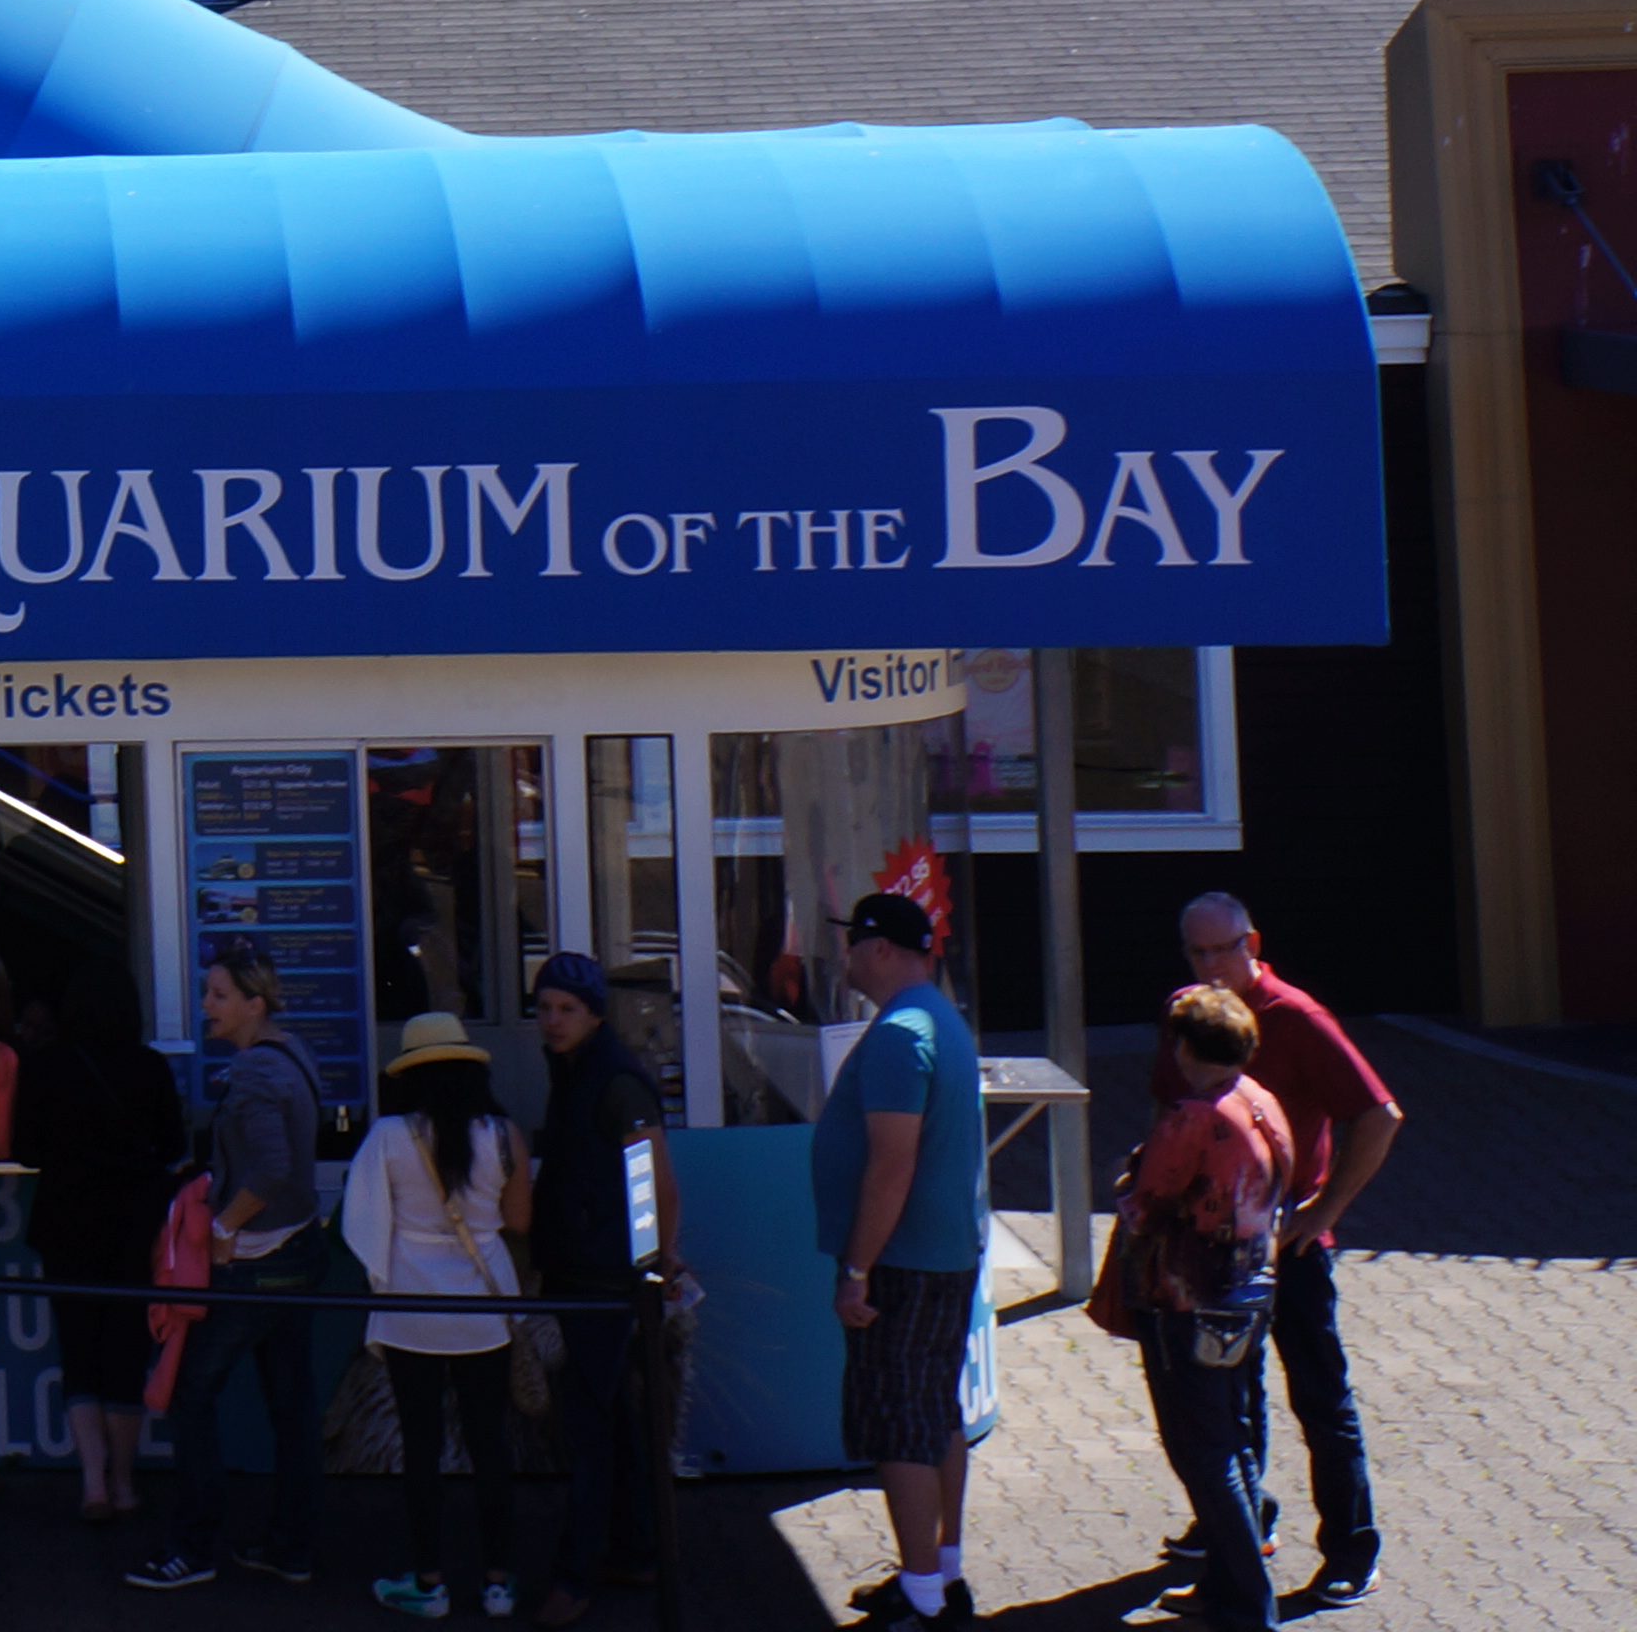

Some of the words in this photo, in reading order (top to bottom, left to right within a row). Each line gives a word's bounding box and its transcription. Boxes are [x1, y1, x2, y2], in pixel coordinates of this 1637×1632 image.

[601, 511, 718, 576] OF
[737, 507, 913, 571] THE
[928, 404, 1286, 568] BAY
[812, 653, 940, 703] Visitor
